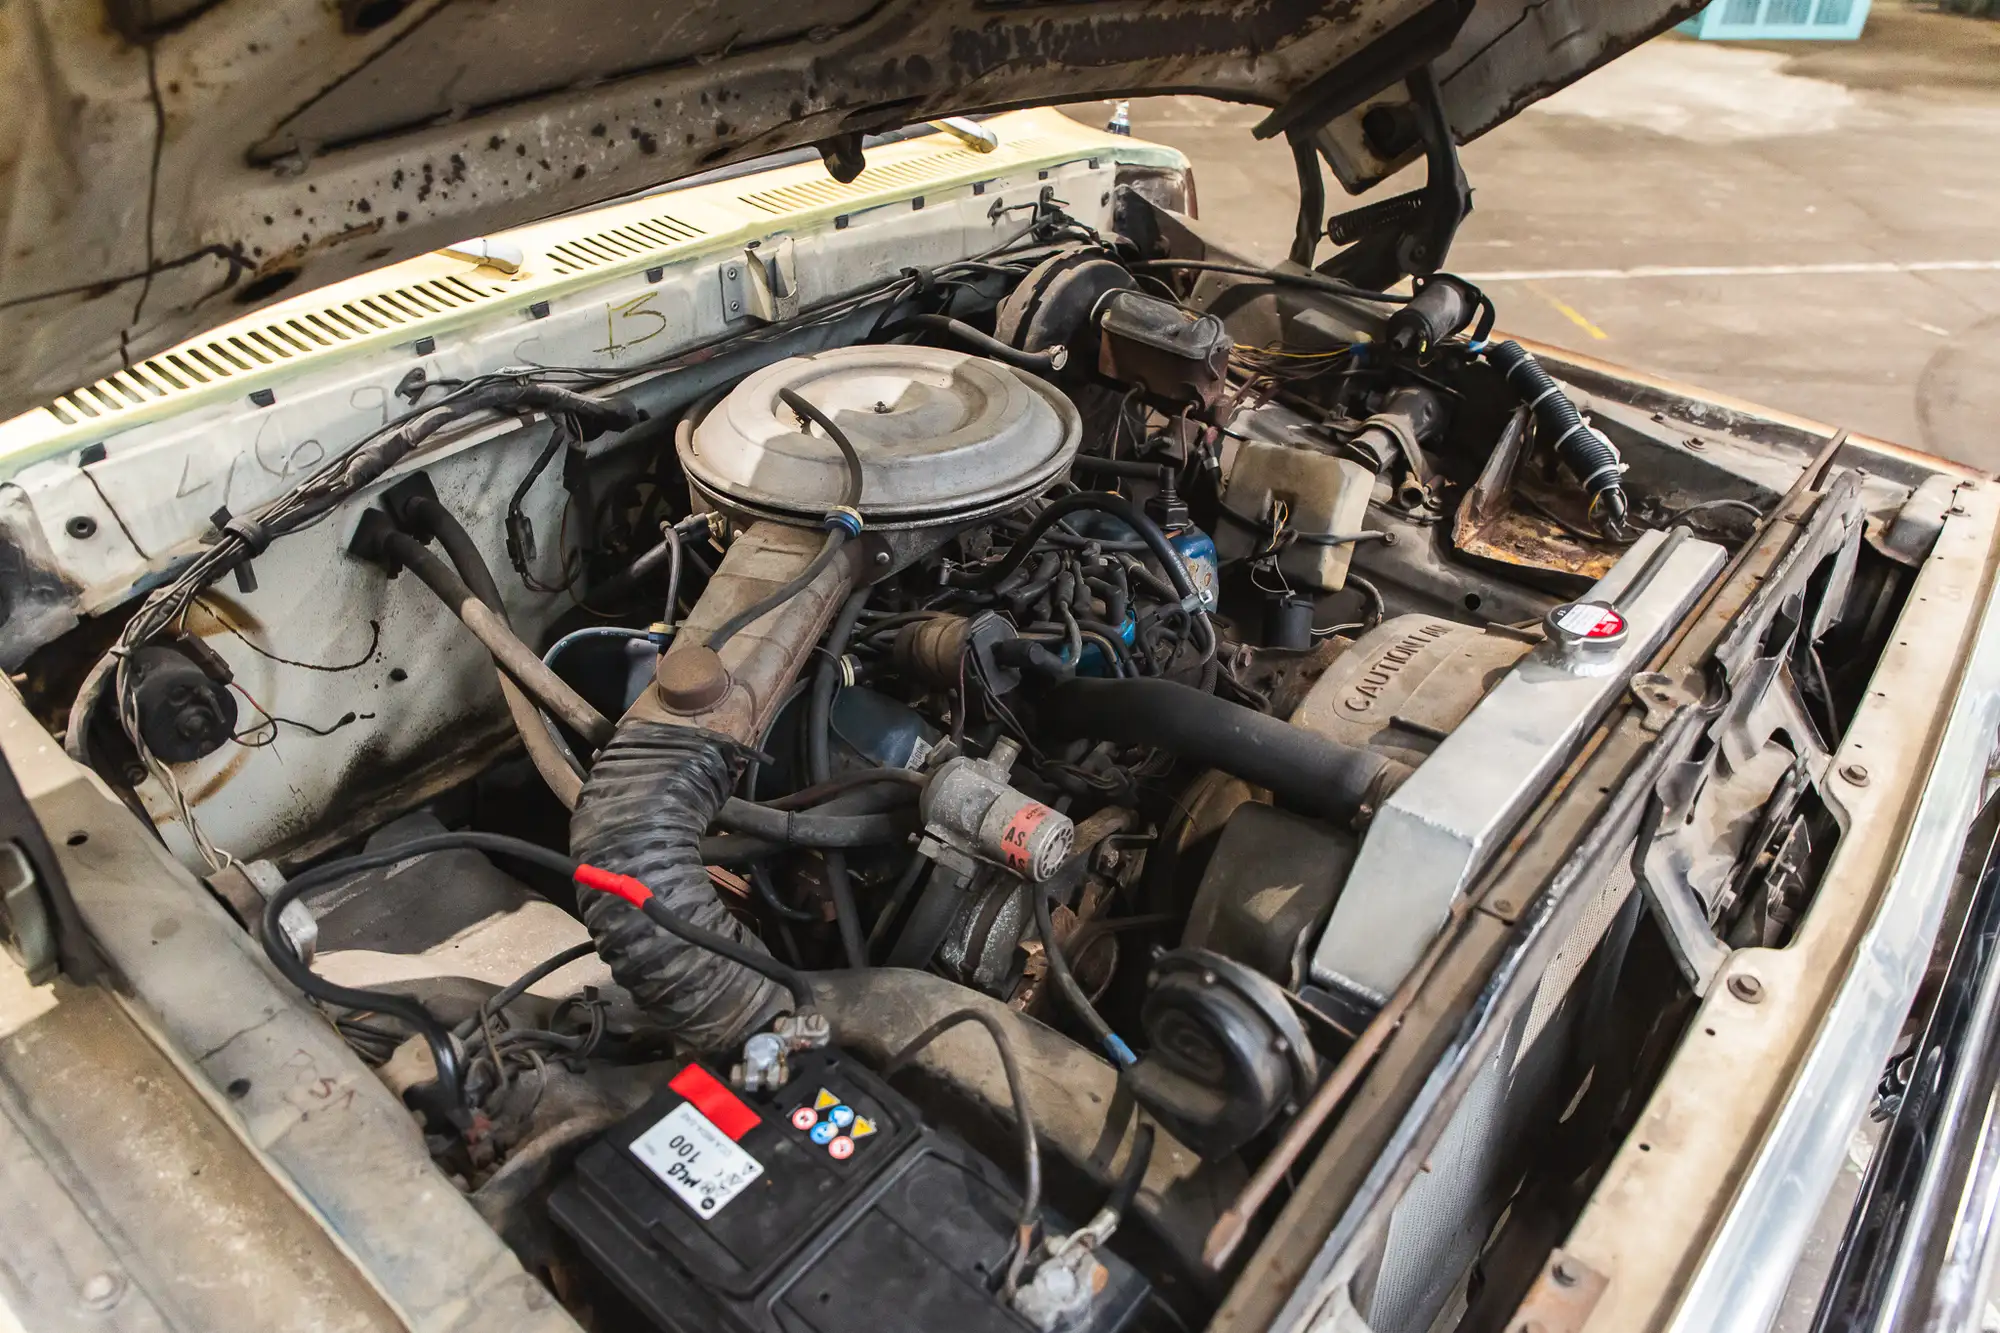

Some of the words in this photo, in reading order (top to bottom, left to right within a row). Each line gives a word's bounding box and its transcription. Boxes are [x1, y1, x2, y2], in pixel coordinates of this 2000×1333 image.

[1345, 640, 1424, 712] CAUTION
[1004, 826, 1026, 847] AS
[668, 1135, 702, 1163] 100
